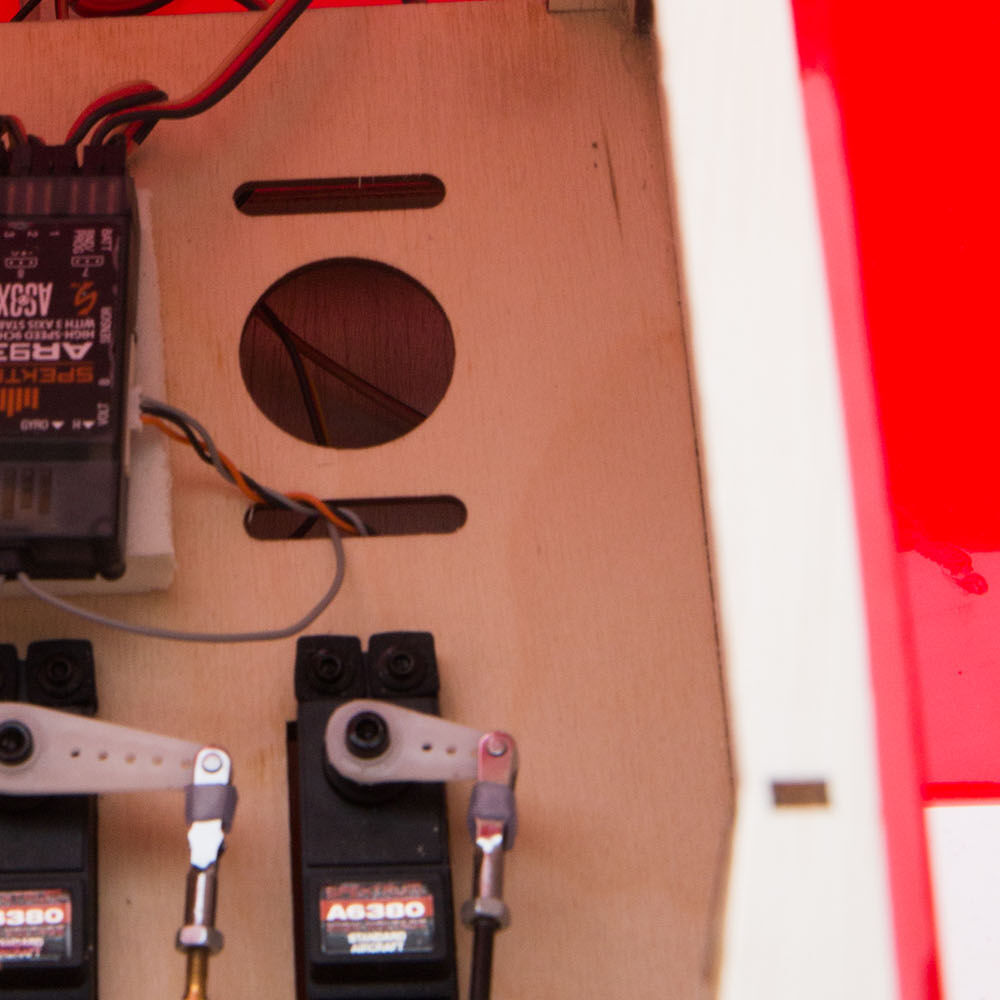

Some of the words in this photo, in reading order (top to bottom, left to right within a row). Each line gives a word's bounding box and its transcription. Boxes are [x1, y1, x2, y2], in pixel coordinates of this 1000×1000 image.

[28, 319, 54, 330] AXIS
[55, 319, 63, 330] 3
[64, 319, 96, 330] WITH
[24, 330, 95, 341] HIGH-SPEED
[326, 901, 426, 922] A6380
